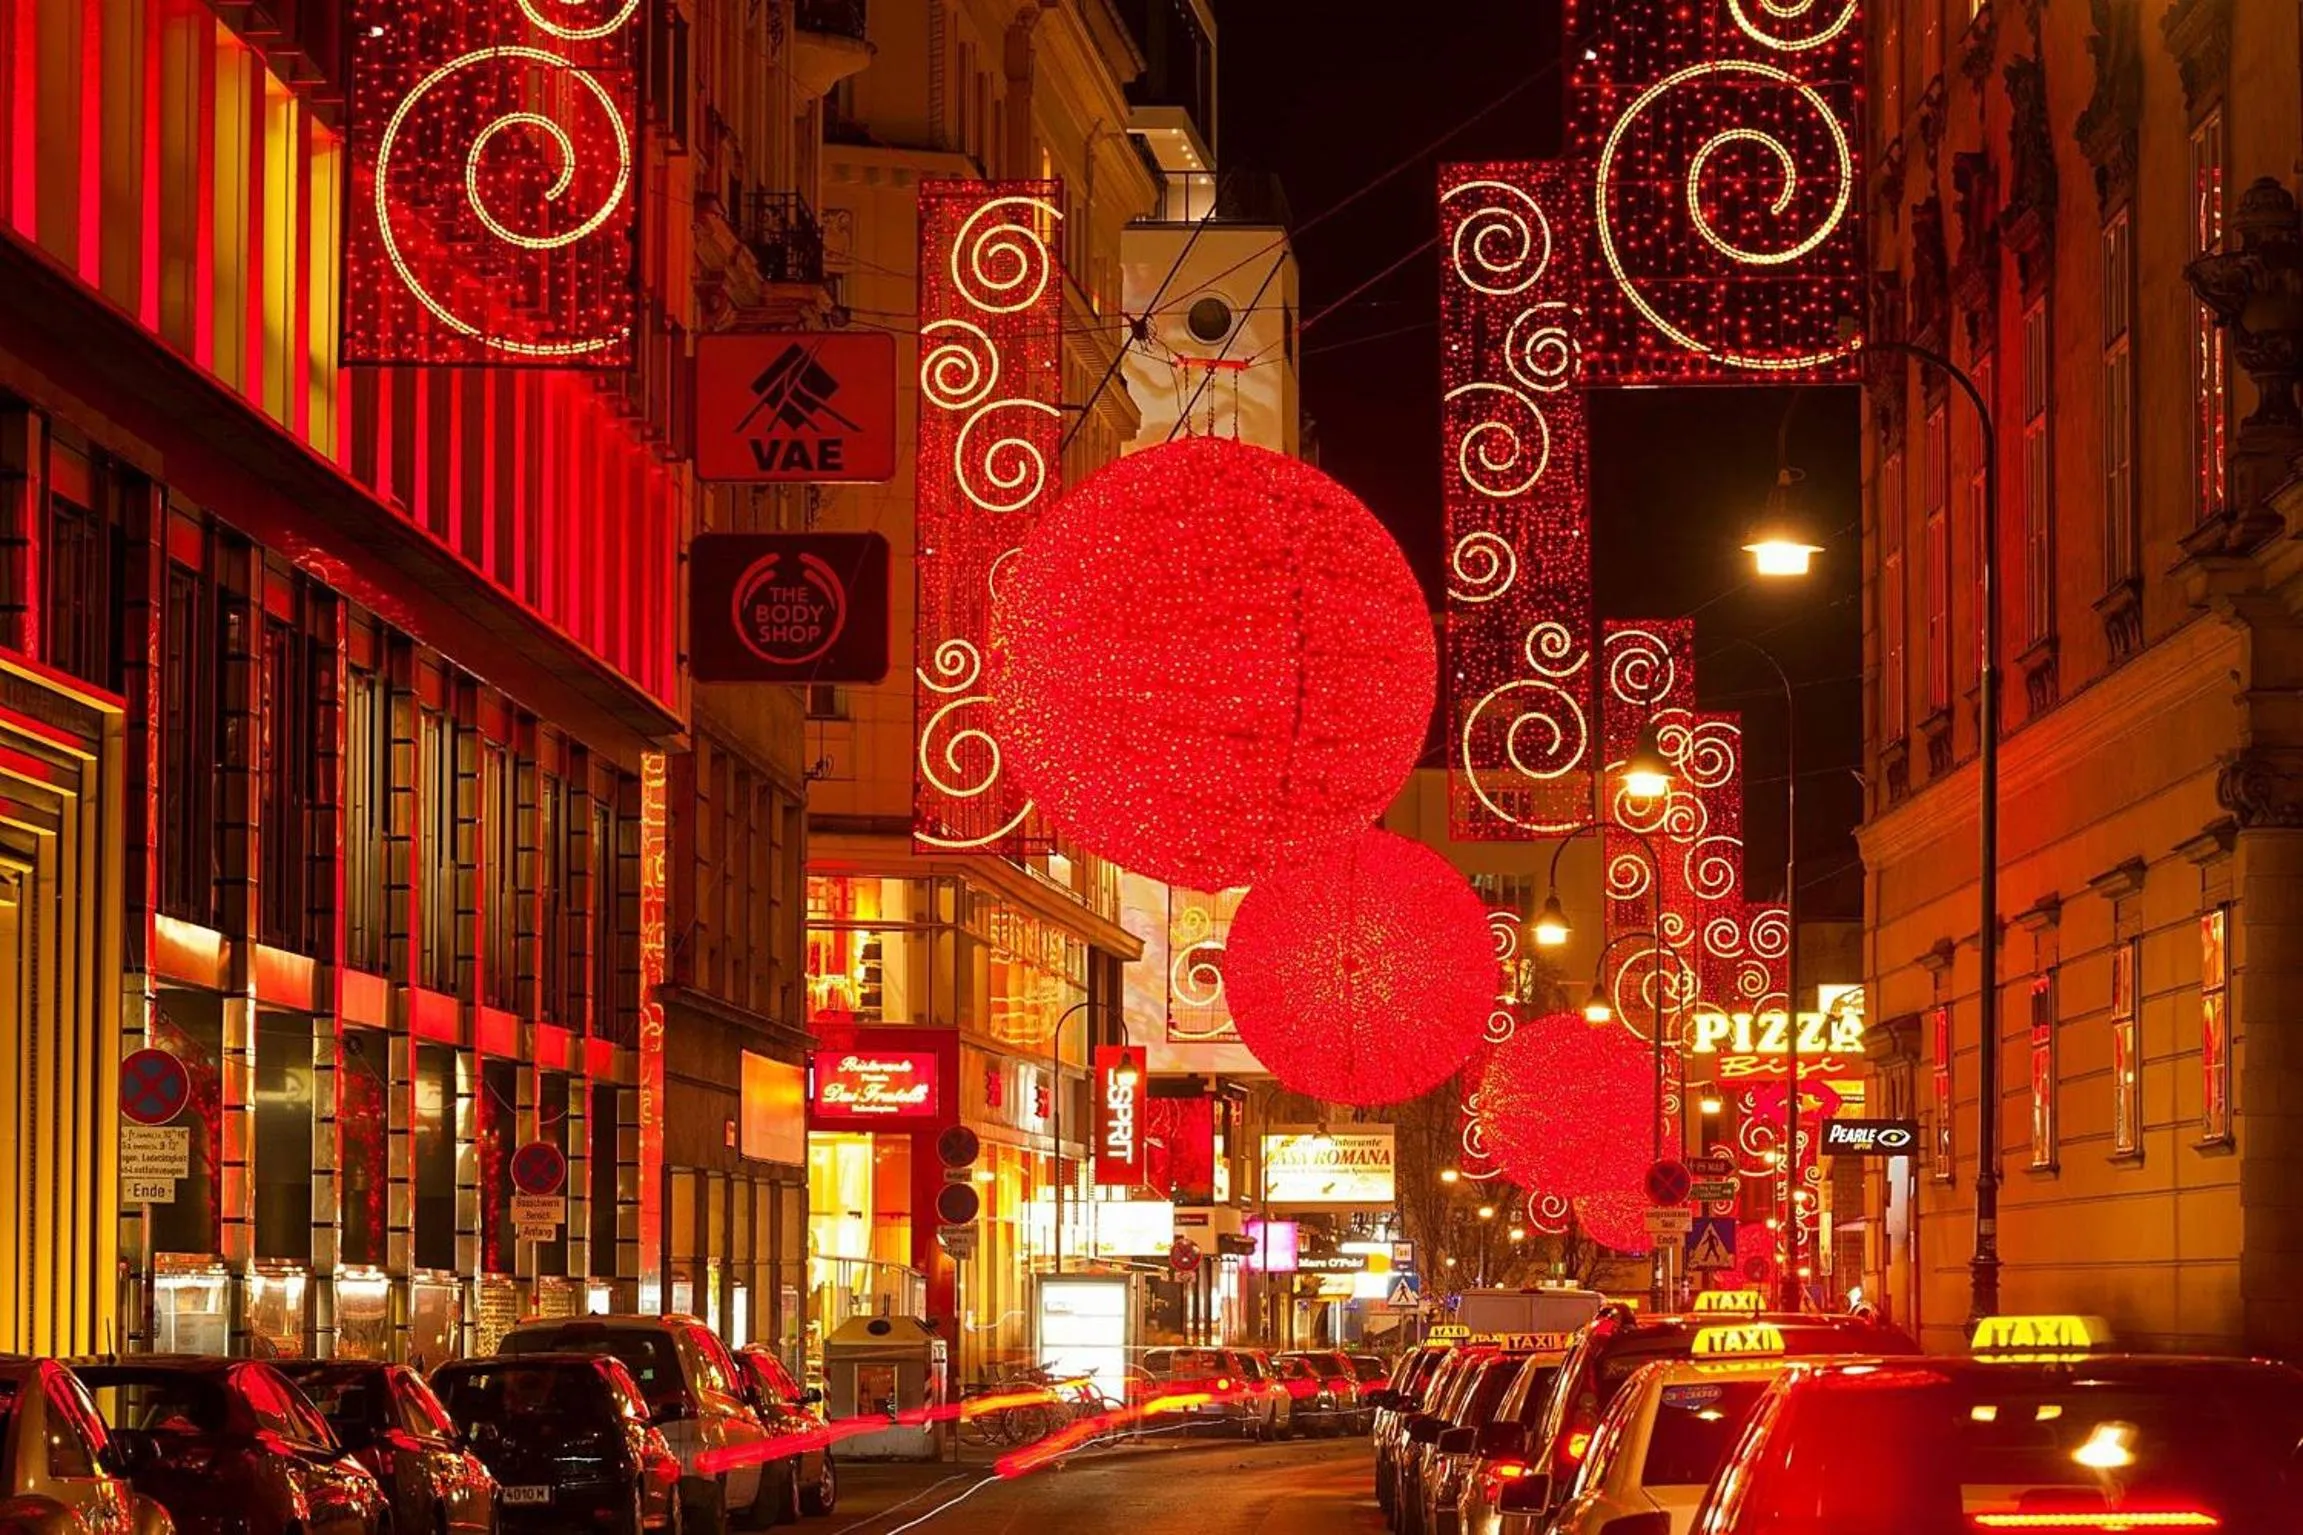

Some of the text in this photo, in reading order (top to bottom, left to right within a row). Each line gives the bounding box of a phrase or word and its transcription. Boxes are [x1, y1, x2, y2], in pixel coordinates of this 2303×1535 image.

[750, 438, 844, 472] VAE
[769, 587, 808, 602] THE
[755, 605, 824, 624] BODY
[758, 626, 821, 643] SHOP
[1692, 1011, 1866, 1053] PIZZA
[1828, 1123, 1878, 1143] PEARLE
[1314, 1149, 1391, 1166] ROMANA
[133, 1183, 165, 1198] Ende
[523, 1225, 554, 1239] Anfang
[1656, 1233, 1679, 1245] Ende
[1711, 1294, 1757, 1311] TAXI
[1436, 1326, 1463, 1337] TAXI
[1993, 1321, 2071, 1347] TAXI
[1511, 1334, 1555, 1349] TAXI
[1709, 1330, 1772, 1353] TAXI
